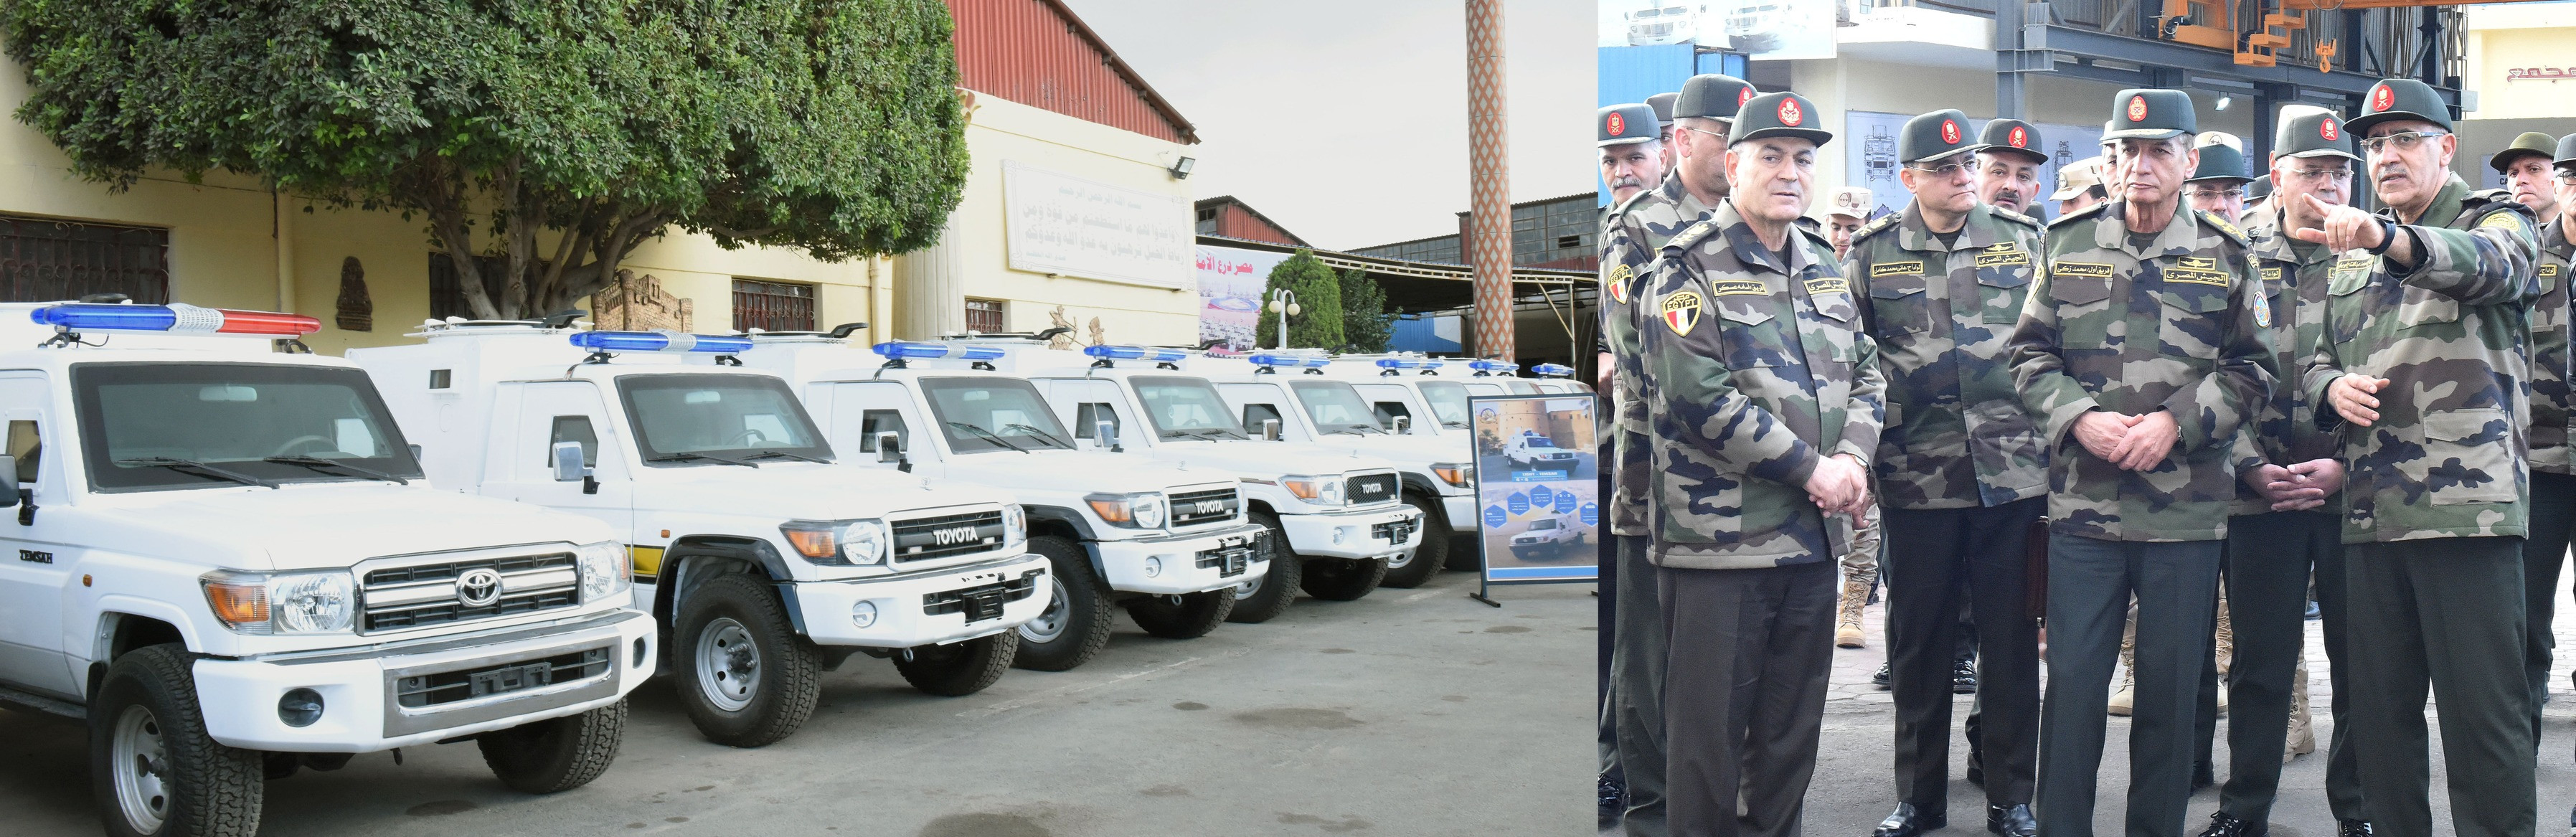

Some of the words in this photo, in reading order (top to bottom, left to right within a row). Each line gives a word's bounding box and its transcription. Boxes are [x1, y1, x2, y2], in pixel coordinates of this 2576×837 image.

[1059, 186, 1085, 198] الرحيم
[1088, 193, 1113, 204] الرحمن
[1114, 197, 1125, 207] الله
[2003, 254, 2024, 263] الجيش
[1218, 260, 1232, 275] درع
[1234, 263, 1253, 275] مصر
[1610, 269, 1629, 283] EGYPT
[2197, 273, 2226, 282] الجيش
[1667, 298, 1696, 311] EGYPT
[1362, 483, 1382, 493] TOYOTA
[1194, 499, 1224, 514] TOYOTA
[933, 526, 978, 545] TOYOTA
